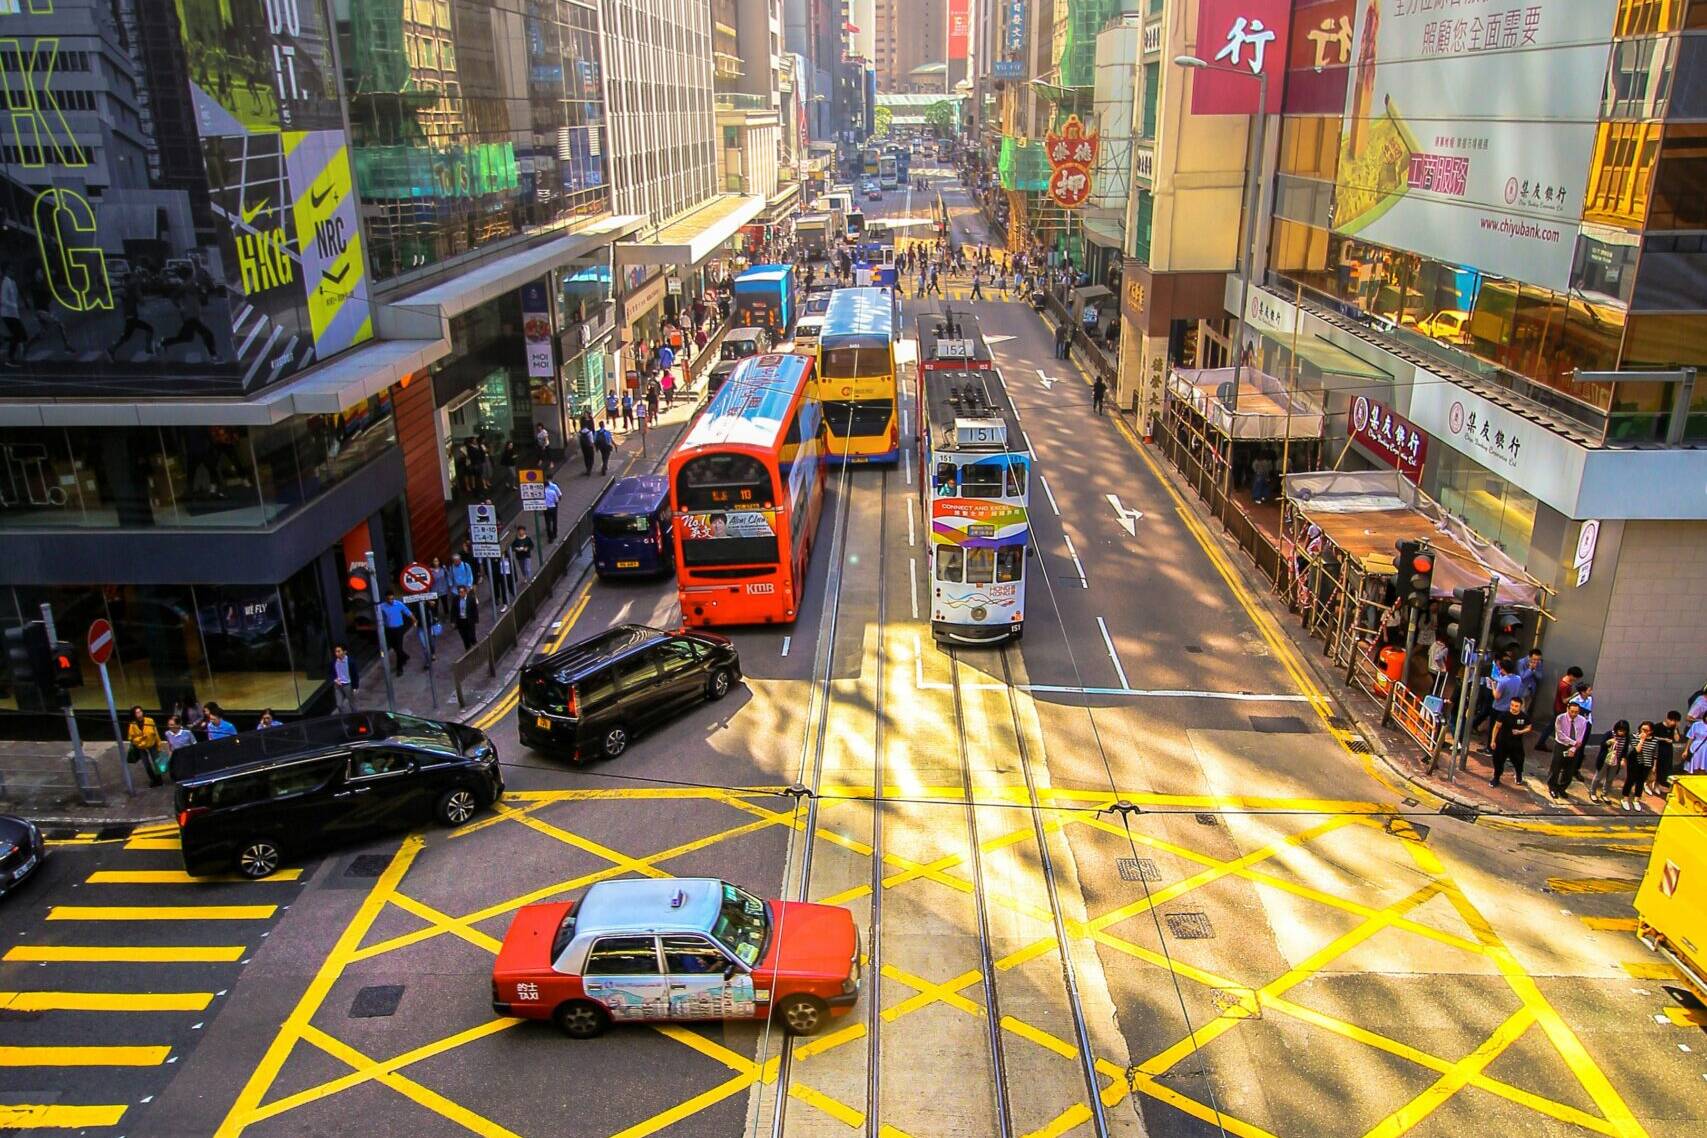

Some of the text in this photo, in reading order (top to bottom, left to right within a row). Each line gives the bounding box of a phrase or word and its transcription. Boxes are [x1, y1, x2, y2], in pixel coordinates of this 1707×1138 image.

[1215, 16, 1276, 74] 行
[1408, 157, 1467, 195] 工商服務
[315, 216, 347, 259] NRC
[1480, 217, 1559, 243] www.chiyubank.com
[236, 227, 293, 296] HKG
[947, 345, 966, 355] 152
[970, 428, 995, 441] 151
[1466, 411, 1521, 459] 集友銀行
[942, 503, 974, 511] CONNECT
[746, 583, 775, 595] KMB
[516, 982, 538, 991] 的士
[518, 992, 539, 1000] TAXI
